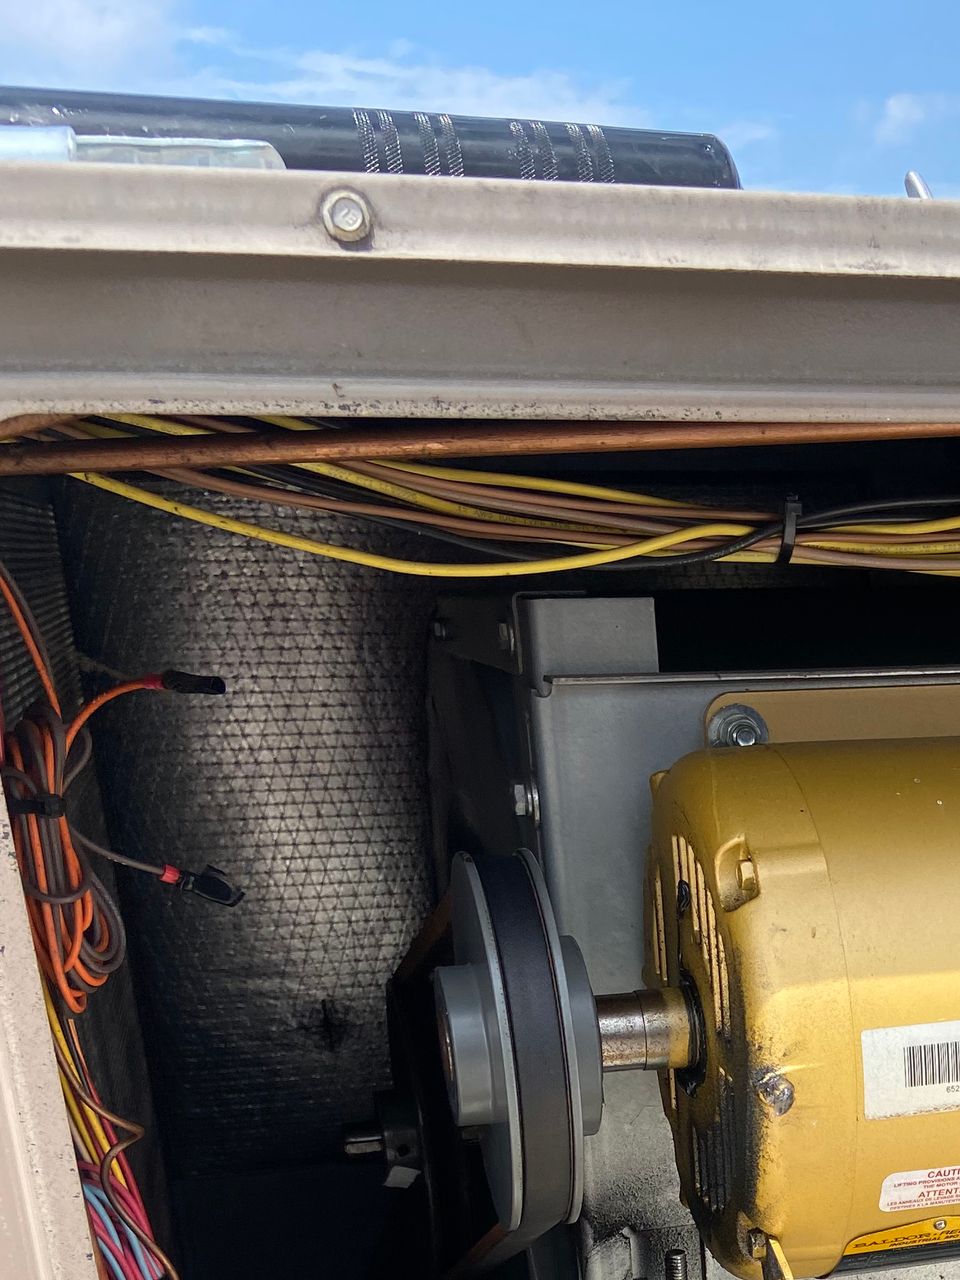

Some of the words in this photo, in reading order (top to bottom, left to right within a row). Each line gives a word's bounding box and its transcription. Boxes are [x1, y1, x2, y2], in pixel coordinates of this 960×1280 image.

[893, 1180, 918, 1189] LIFTING
[918, 1176, 955, 1186] PROVISIONS
[935, 1181, 959, 1189] MOTOR
[852, 1232, 931, 1249] BALDOR
[888, 1236, 942, 1248] INDUSTRIAL
